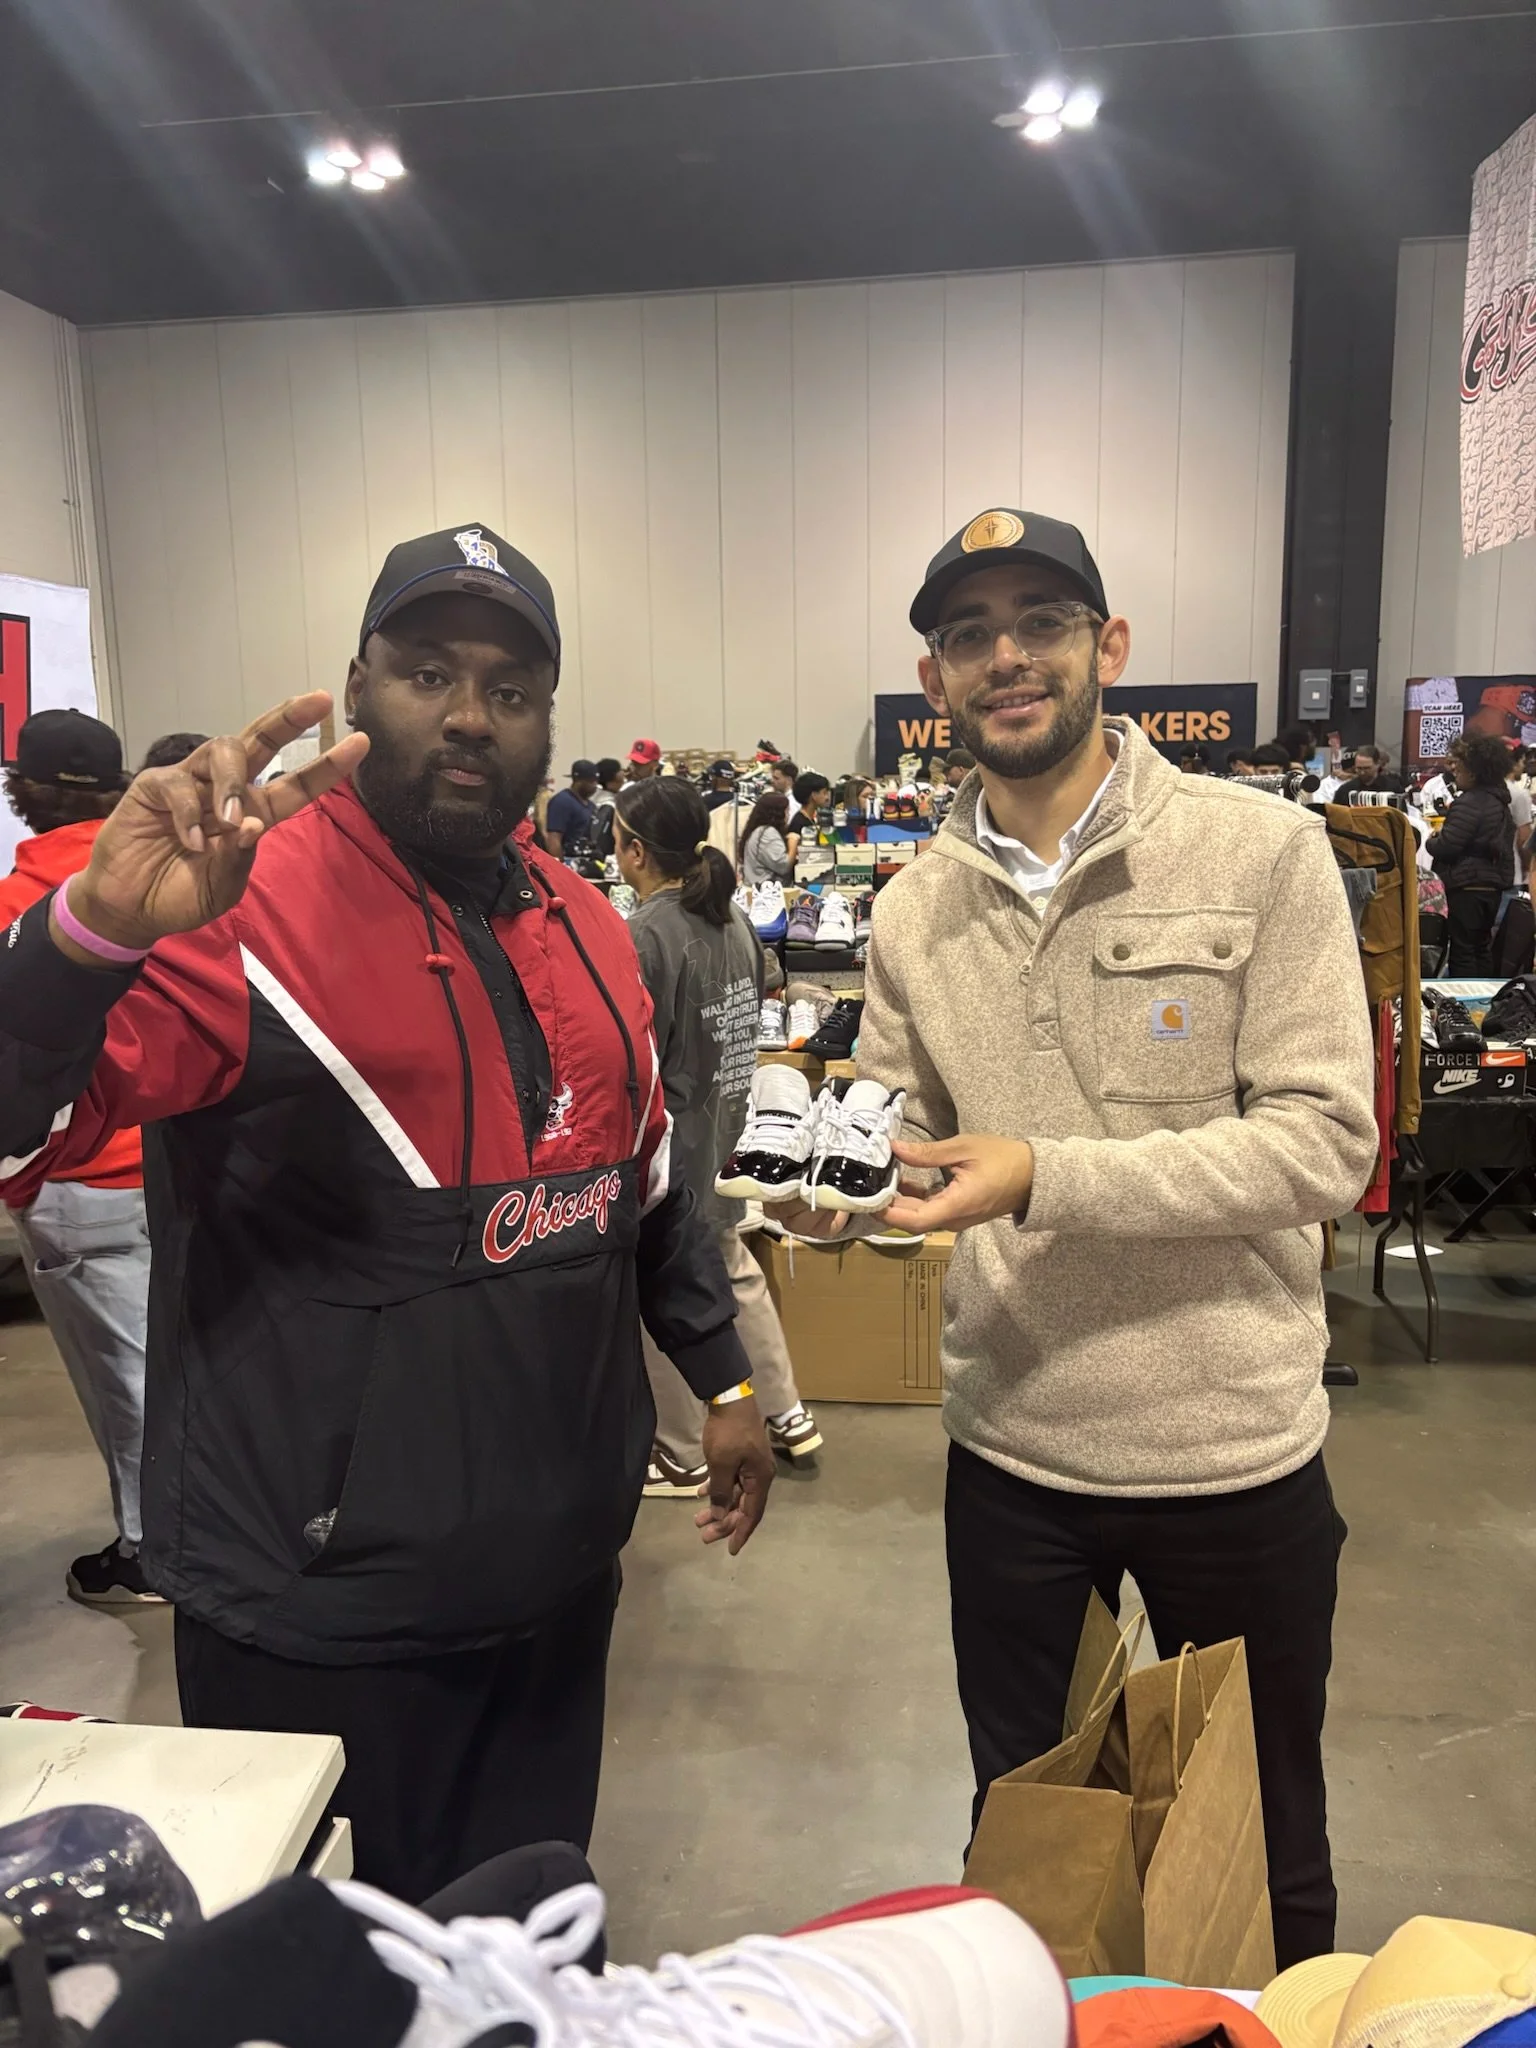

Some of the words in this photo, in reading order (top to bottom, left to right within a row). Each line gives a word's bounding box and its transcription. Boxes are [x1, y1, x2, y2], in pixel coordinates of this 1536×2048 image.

[898, 719, 951, 748] WE
[1141, 709, 1231, 742] KERS
[1425, 1053, 1473, 1066] FORCE
[1441, 1069, 1479, 1083] NIKE
[482, 1169, 622, 1263] Chicago
